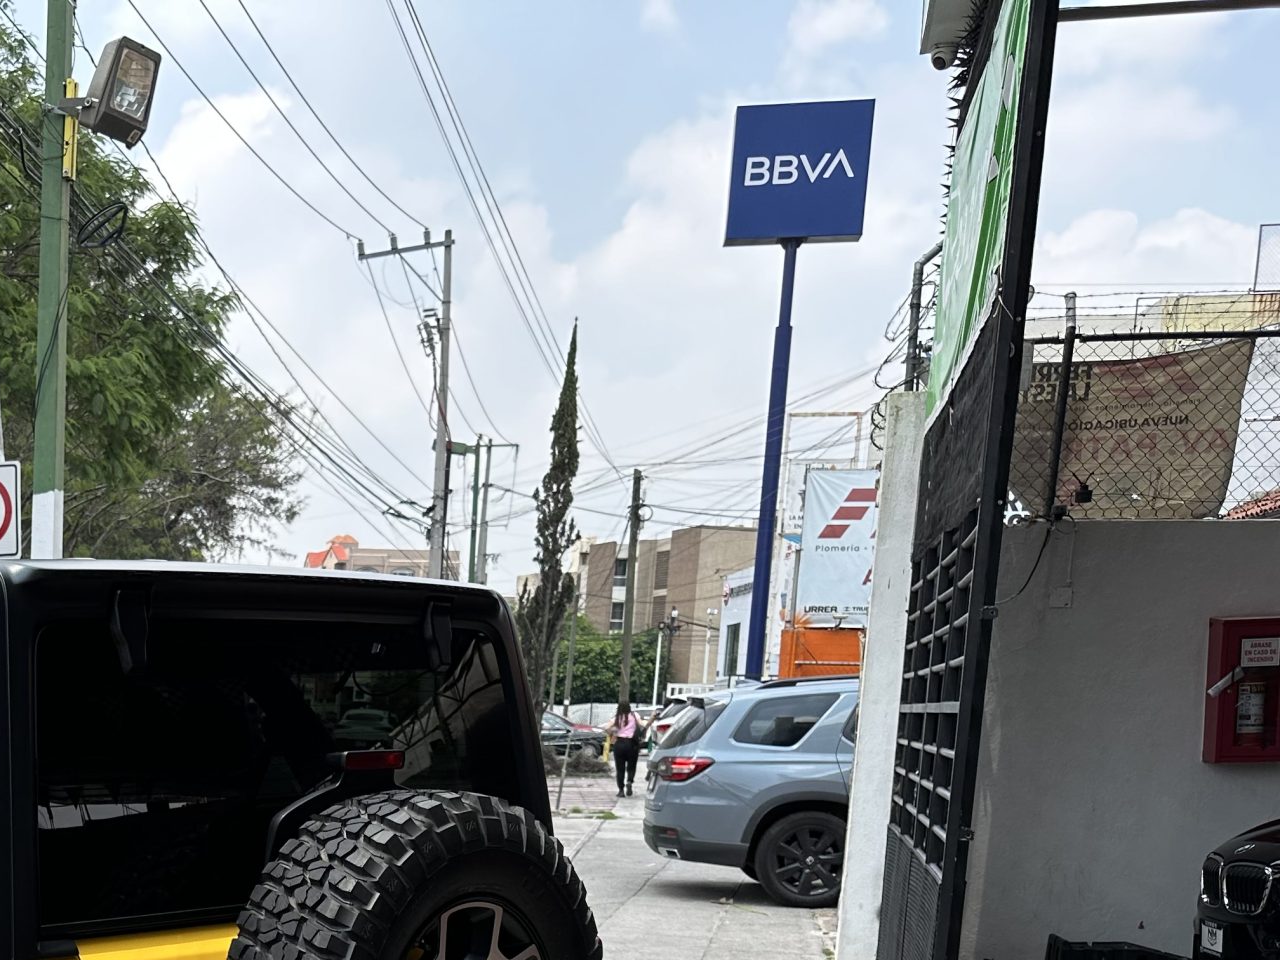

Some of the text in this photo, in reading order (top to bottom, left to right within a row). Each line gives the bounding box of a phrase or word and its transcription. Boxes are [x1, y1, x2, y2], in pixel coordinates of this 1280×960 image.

[744, 148, 855, 186] BBVA
[815, 544, 860, 552] Plomería
[804, 605, 838, 613] URREA
